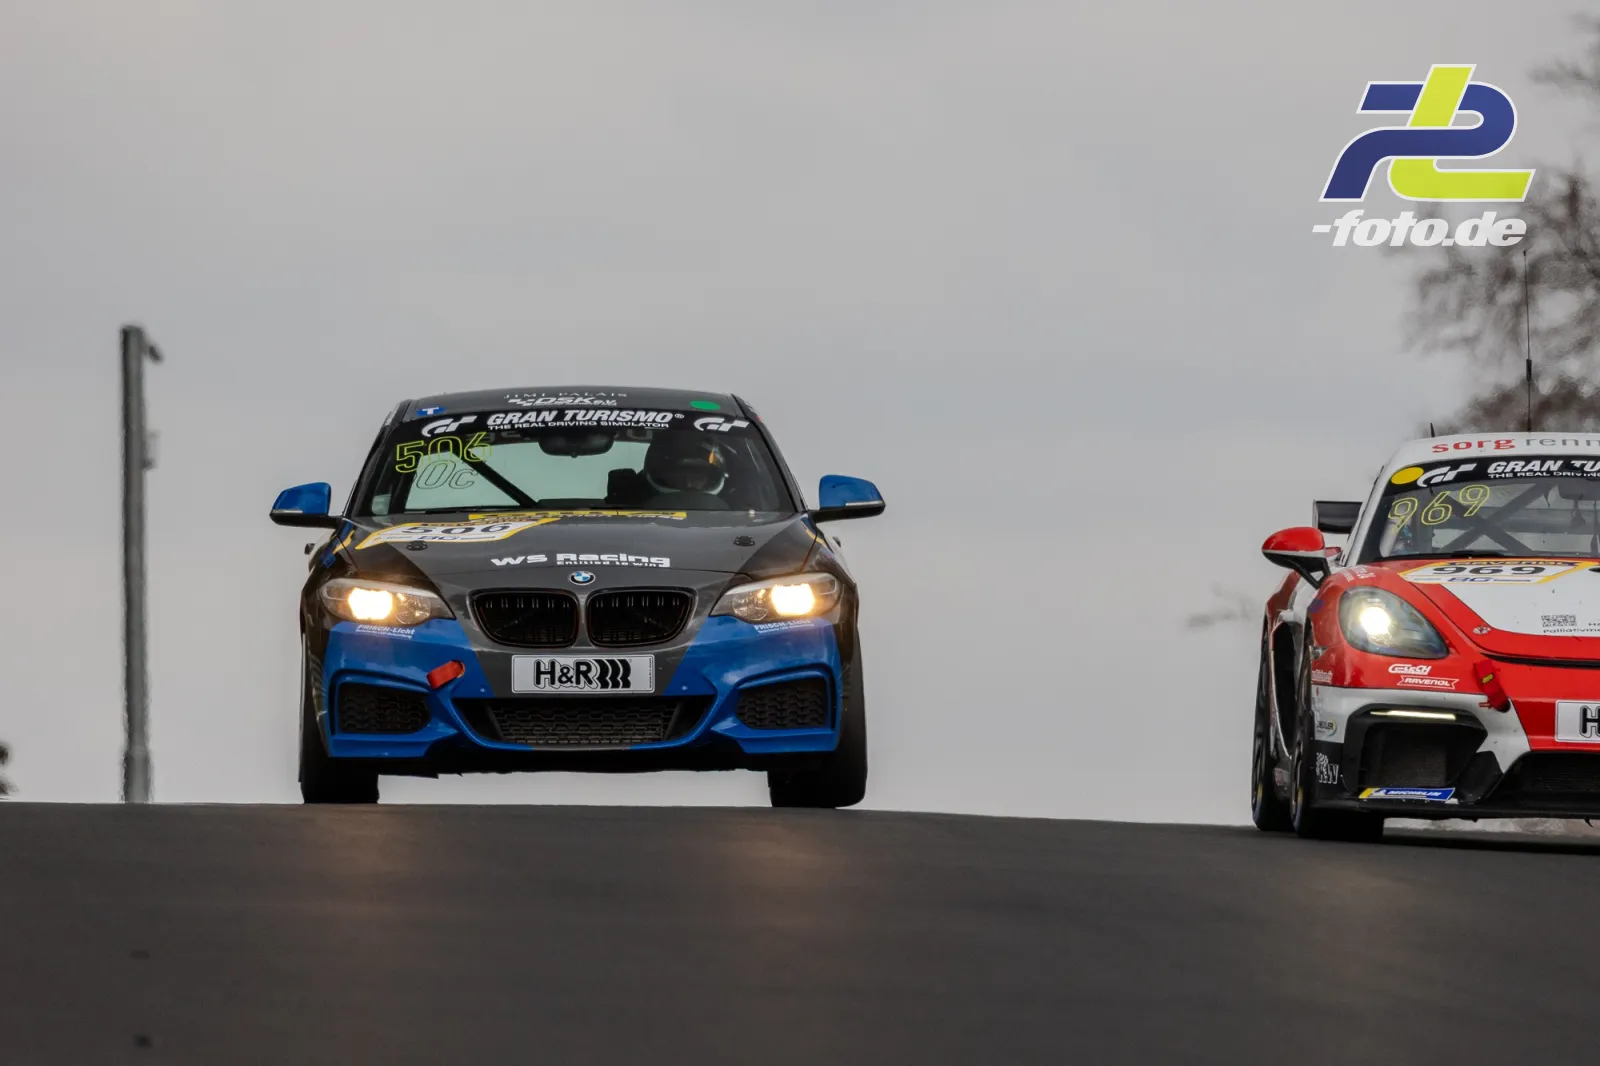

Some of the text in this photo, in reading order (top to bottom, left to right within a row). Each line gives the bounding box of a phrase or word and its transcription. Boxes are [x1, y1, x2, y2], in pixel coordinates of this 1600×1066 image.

[486, 410, 557, 426] GRAN
[395, 432, 493, 473] 506
[1432, 439, 1516, 453] sorg
[1487, 460, 1564, 473] GRAN
[1388, 484, 1490, 532] 969
[401, 522, 512, 535] 506
[556, 553, 671, 568] Racing
[1432, 566, 1546, 575] 969
[534, 659, 599, 689] H&R
[1403, 677, 1451, 687] RAVENOL
